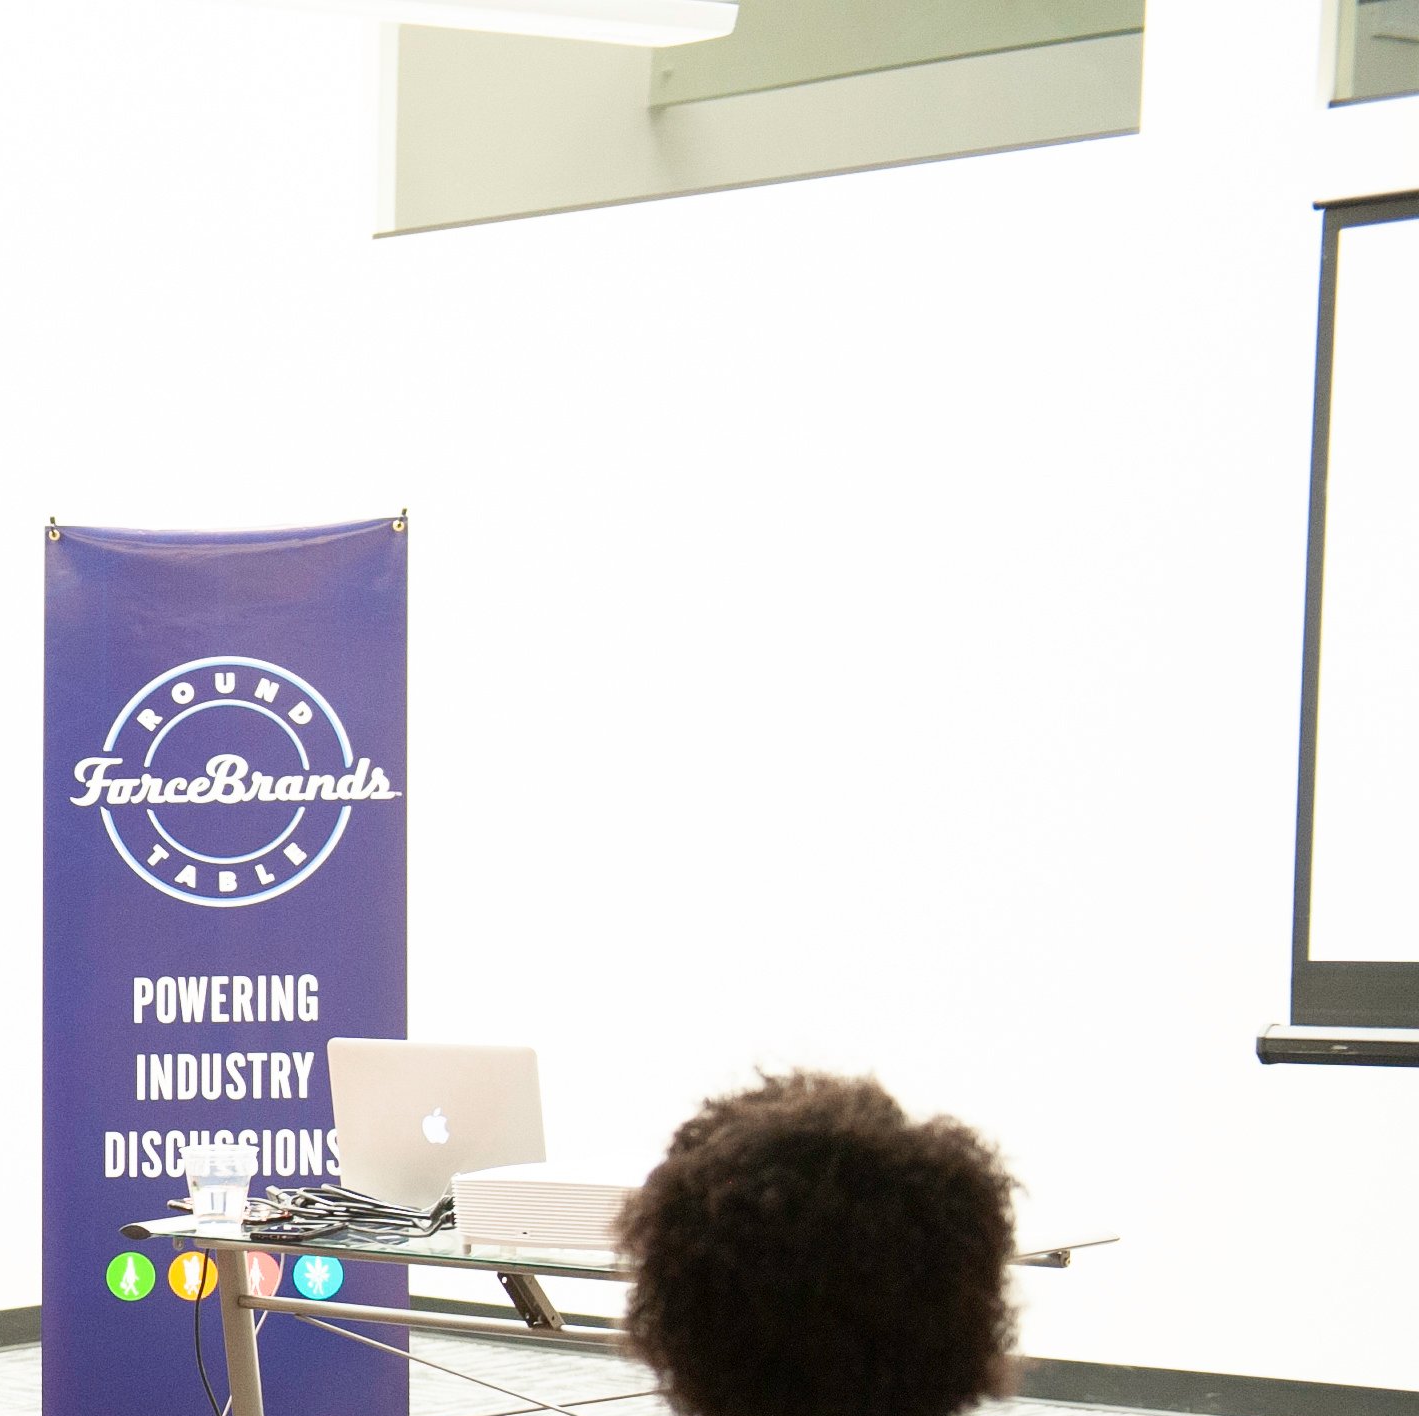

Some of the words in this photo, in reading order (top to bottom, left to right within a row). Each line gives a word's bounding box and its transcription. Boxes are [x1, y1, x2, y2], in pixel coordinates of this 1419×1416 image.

[137, 671, 313, 732] ROUND
[70, 753, 402, 807] ForceBrands
[147, 842, 307, 892] TABLE
[132, 973, 320, 1025] POWERING
[135, 1051, 316, 1101] INDUSTRY
